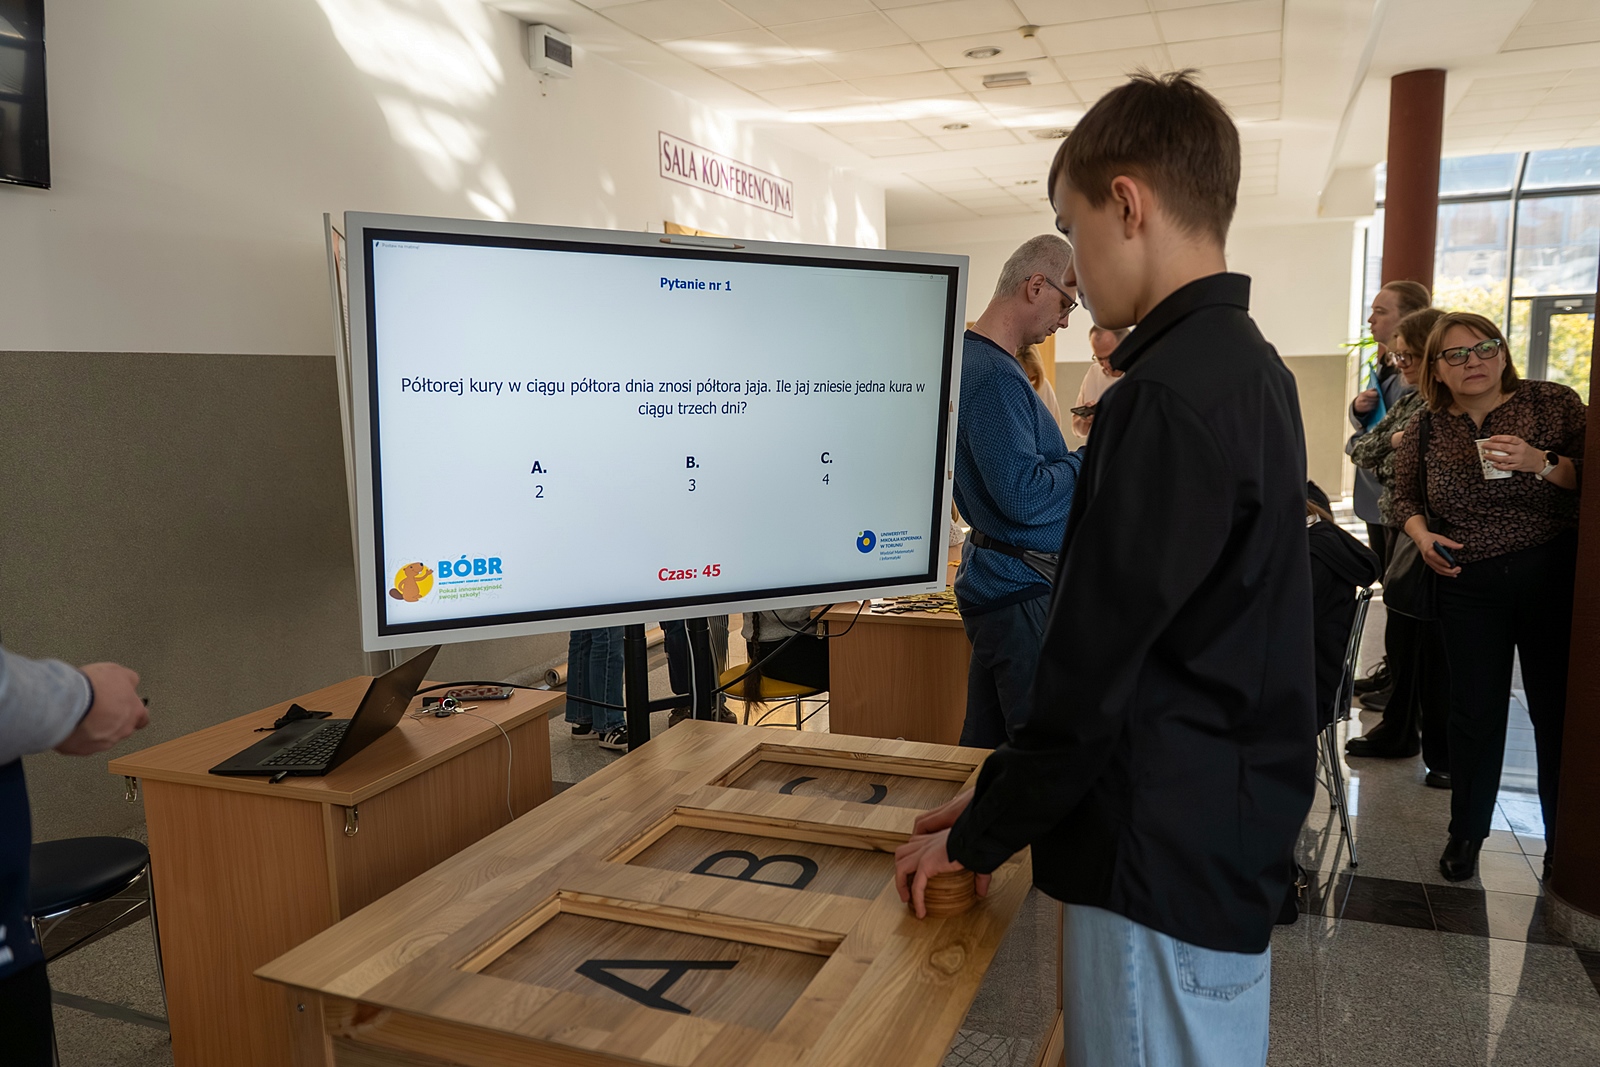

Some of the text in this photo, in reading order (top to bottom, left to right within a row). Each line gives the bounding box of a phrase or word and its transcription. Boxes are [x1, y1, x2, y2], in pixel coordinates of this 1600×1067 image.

[662, 140, 792, 213] SALA KONFERENCYJNA
[660, 277, 732, 291] Pytanie nr 1
[401, 376, 926, 396] Półtorej kury w ciągu półtora dnia znosi półtora jaja. Ile jaj zniesie jedna kura w
[638, 401, 748, 419] ciągu trzech dni?
[686, 456, 700, 469] B.
[820, 452, 833, 465] C.
[531, 461, 548, 475] A.
[688, 479, 697, 492] 3
[822, 473, 830, 486] 4
[535, 485, 545, 499] 2
[438, 555, 503, 578] BÓBR
[658, 563, 721, 582] Czas: 45
[458, 584, 503, 592] innowacyjność
[459, 591, 481, 599] szkoły!
[689, 850, 819, 891] B
[574, 959, 739, 1015] A
